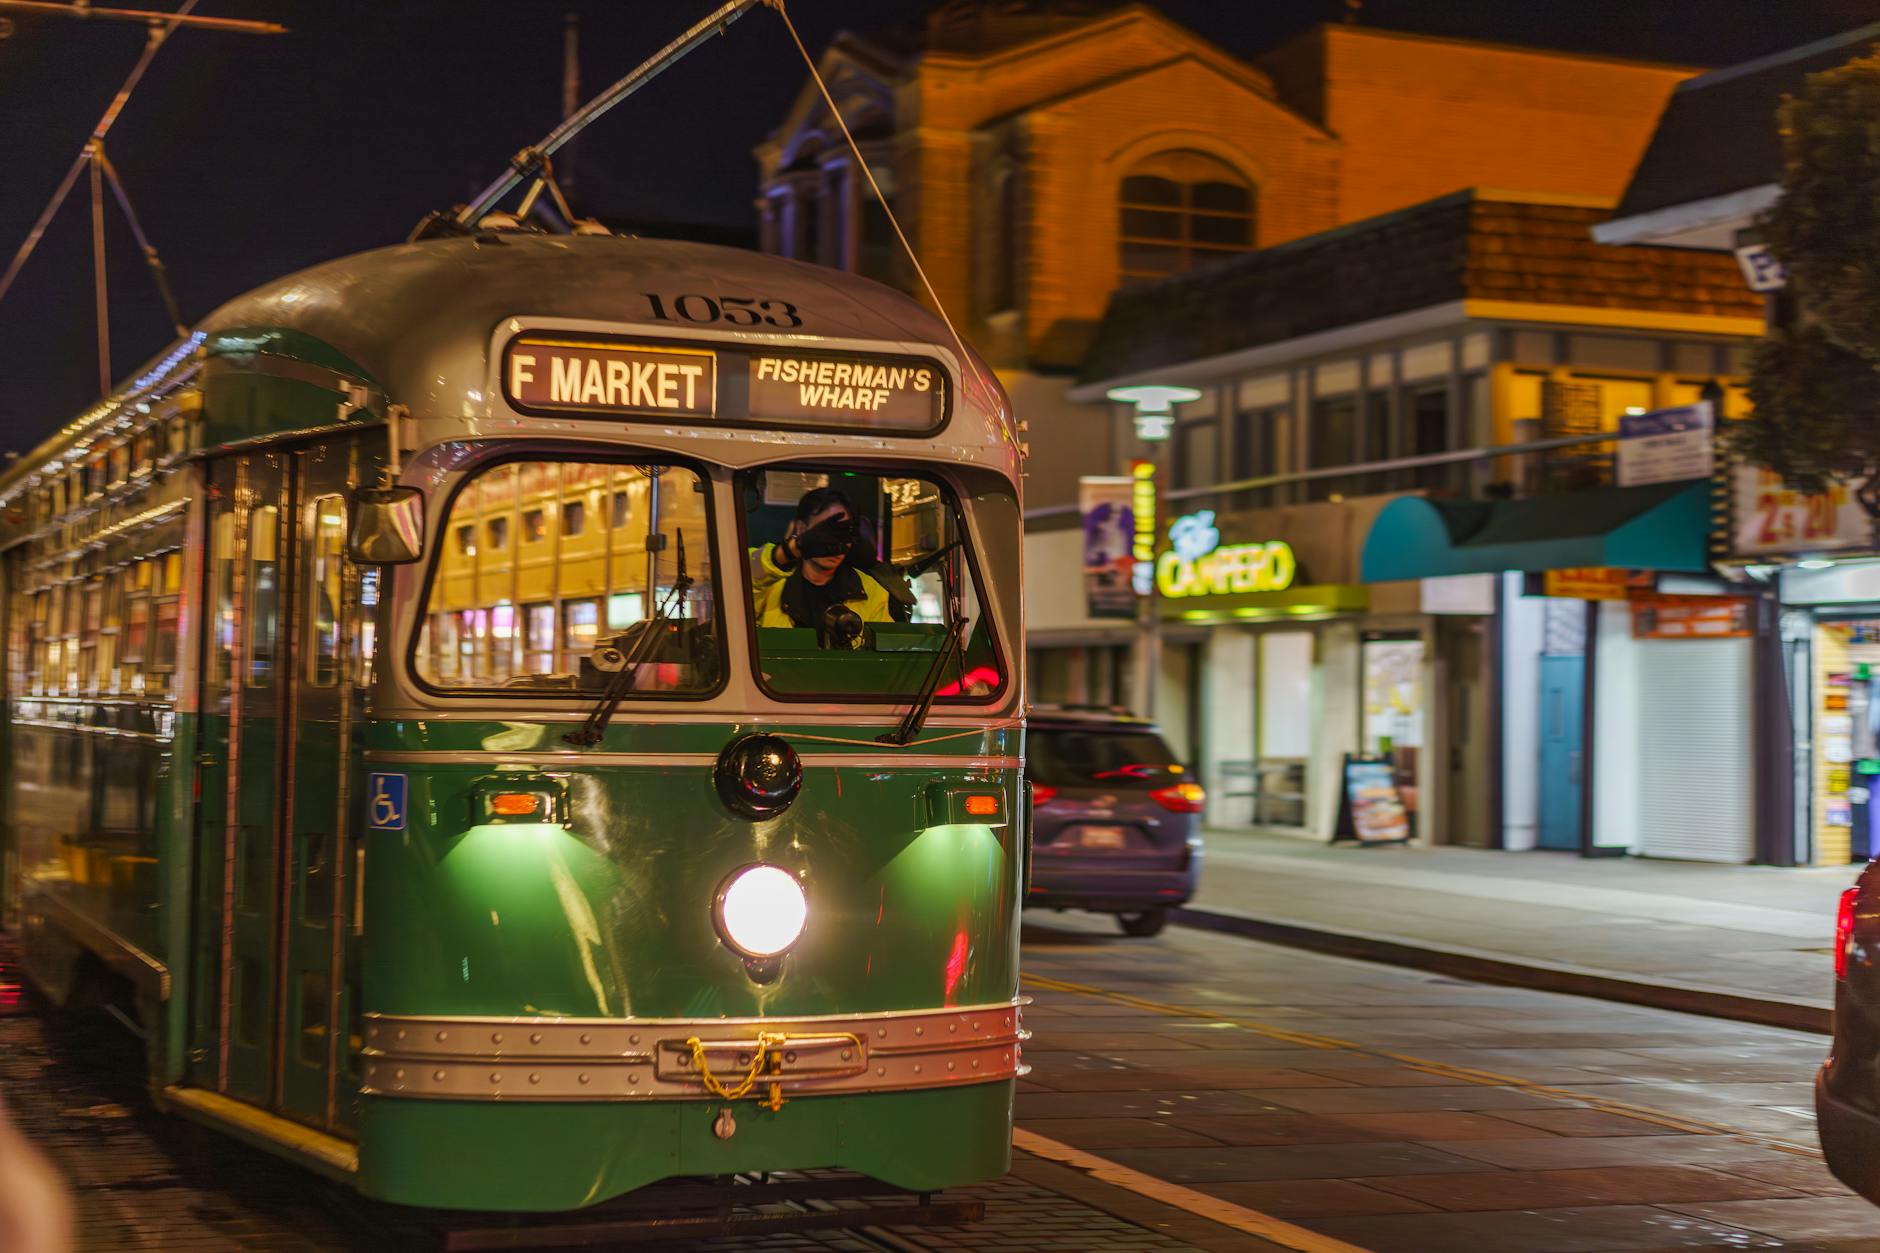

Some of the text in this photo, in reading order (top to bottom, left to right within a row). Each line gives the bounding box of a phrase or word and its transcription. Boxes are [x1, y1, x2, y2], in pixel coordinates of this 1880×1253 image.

[640, 293, 803, 329] 1053
[511, 354, 703, 409] F MARKET
[757, 357, 931, 392] FISHERMAN'S
[800, 383, 889, 411] WHARF
